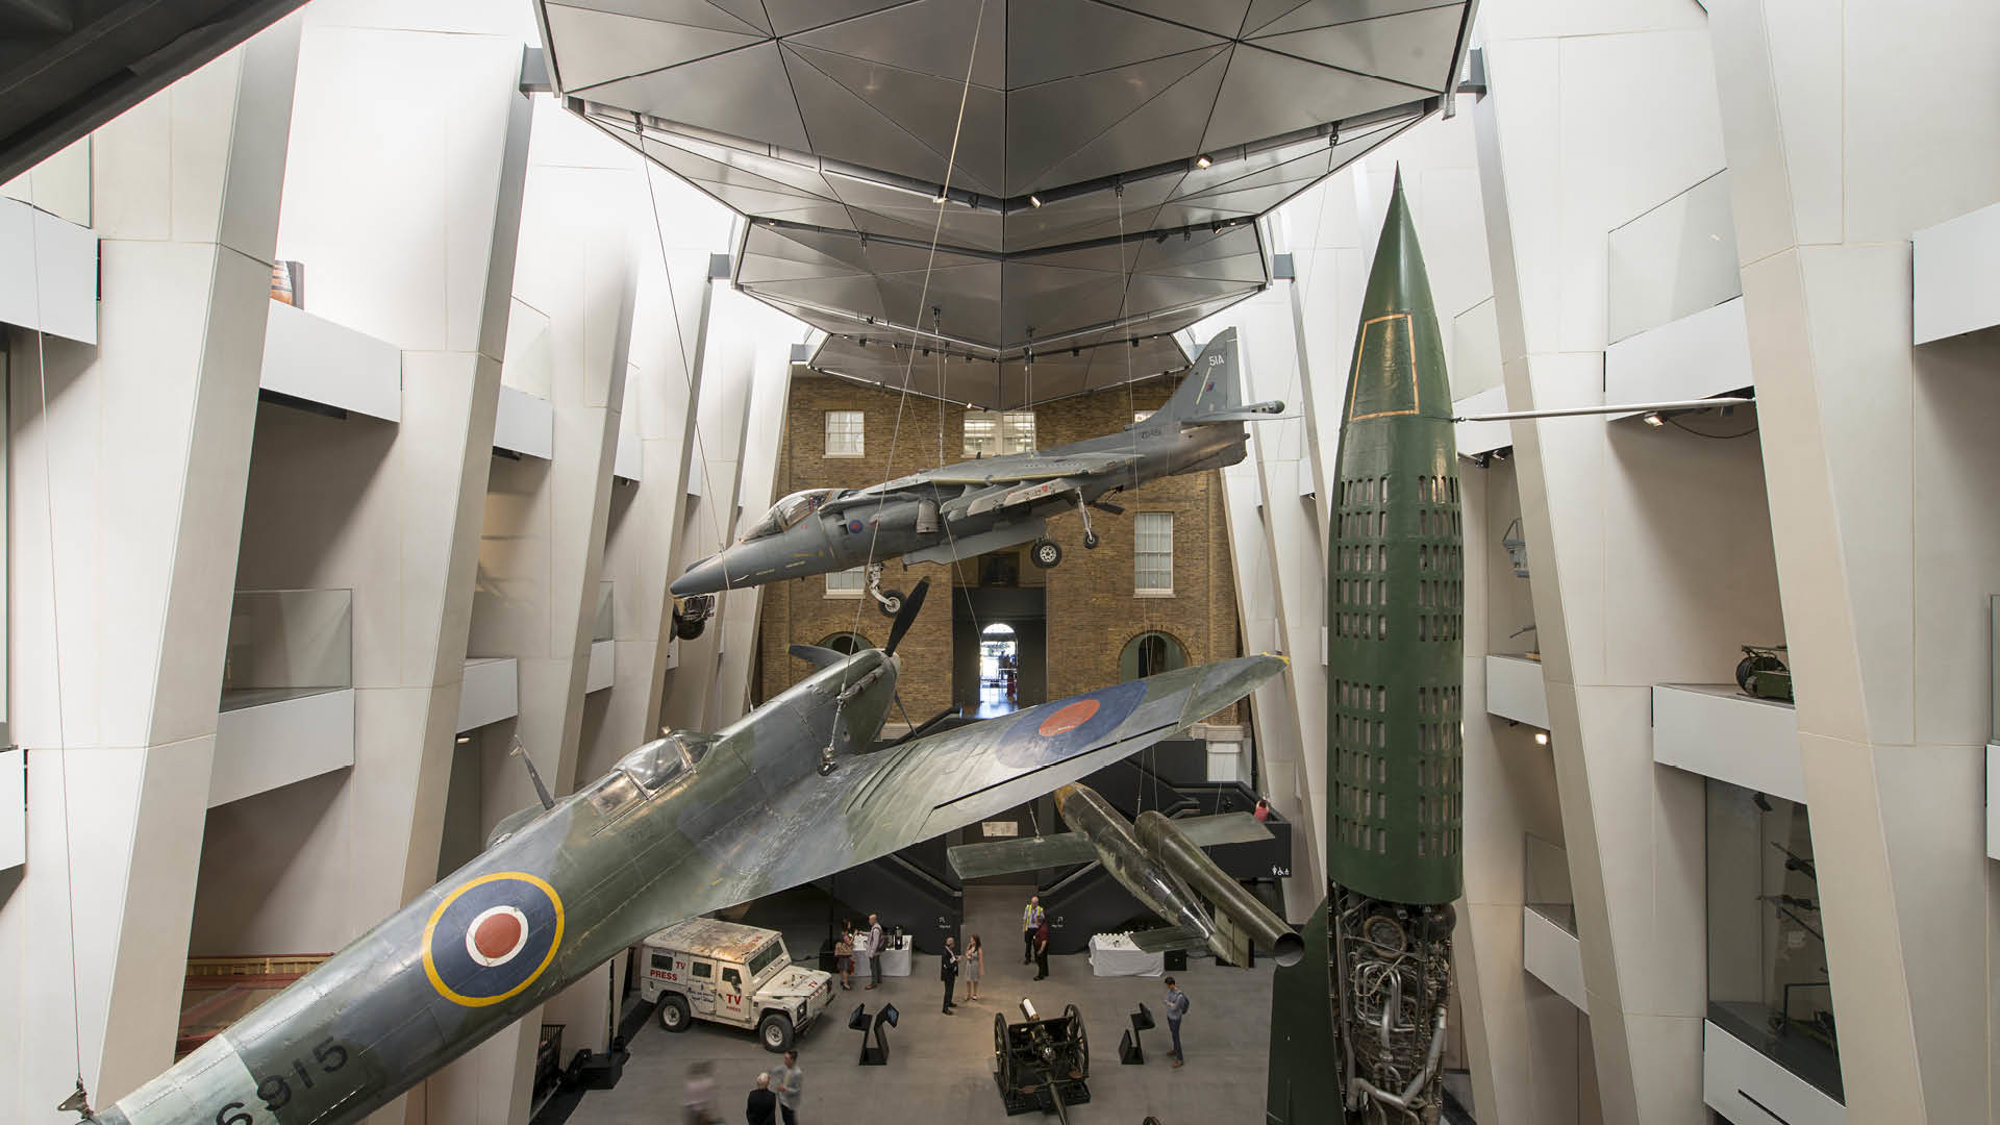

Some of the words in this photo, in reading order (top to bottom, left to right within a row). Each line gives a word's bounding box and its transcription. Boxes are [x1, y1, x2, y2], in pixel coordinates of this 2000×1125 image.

[1208, 354, 1224, 367] 51A
[676, 961, 686, 970] TV
[649, 969, 678, 981] PRESS
[726, 993, 741, 1005] TV
[215, 1036, 348, 1125] 6915
